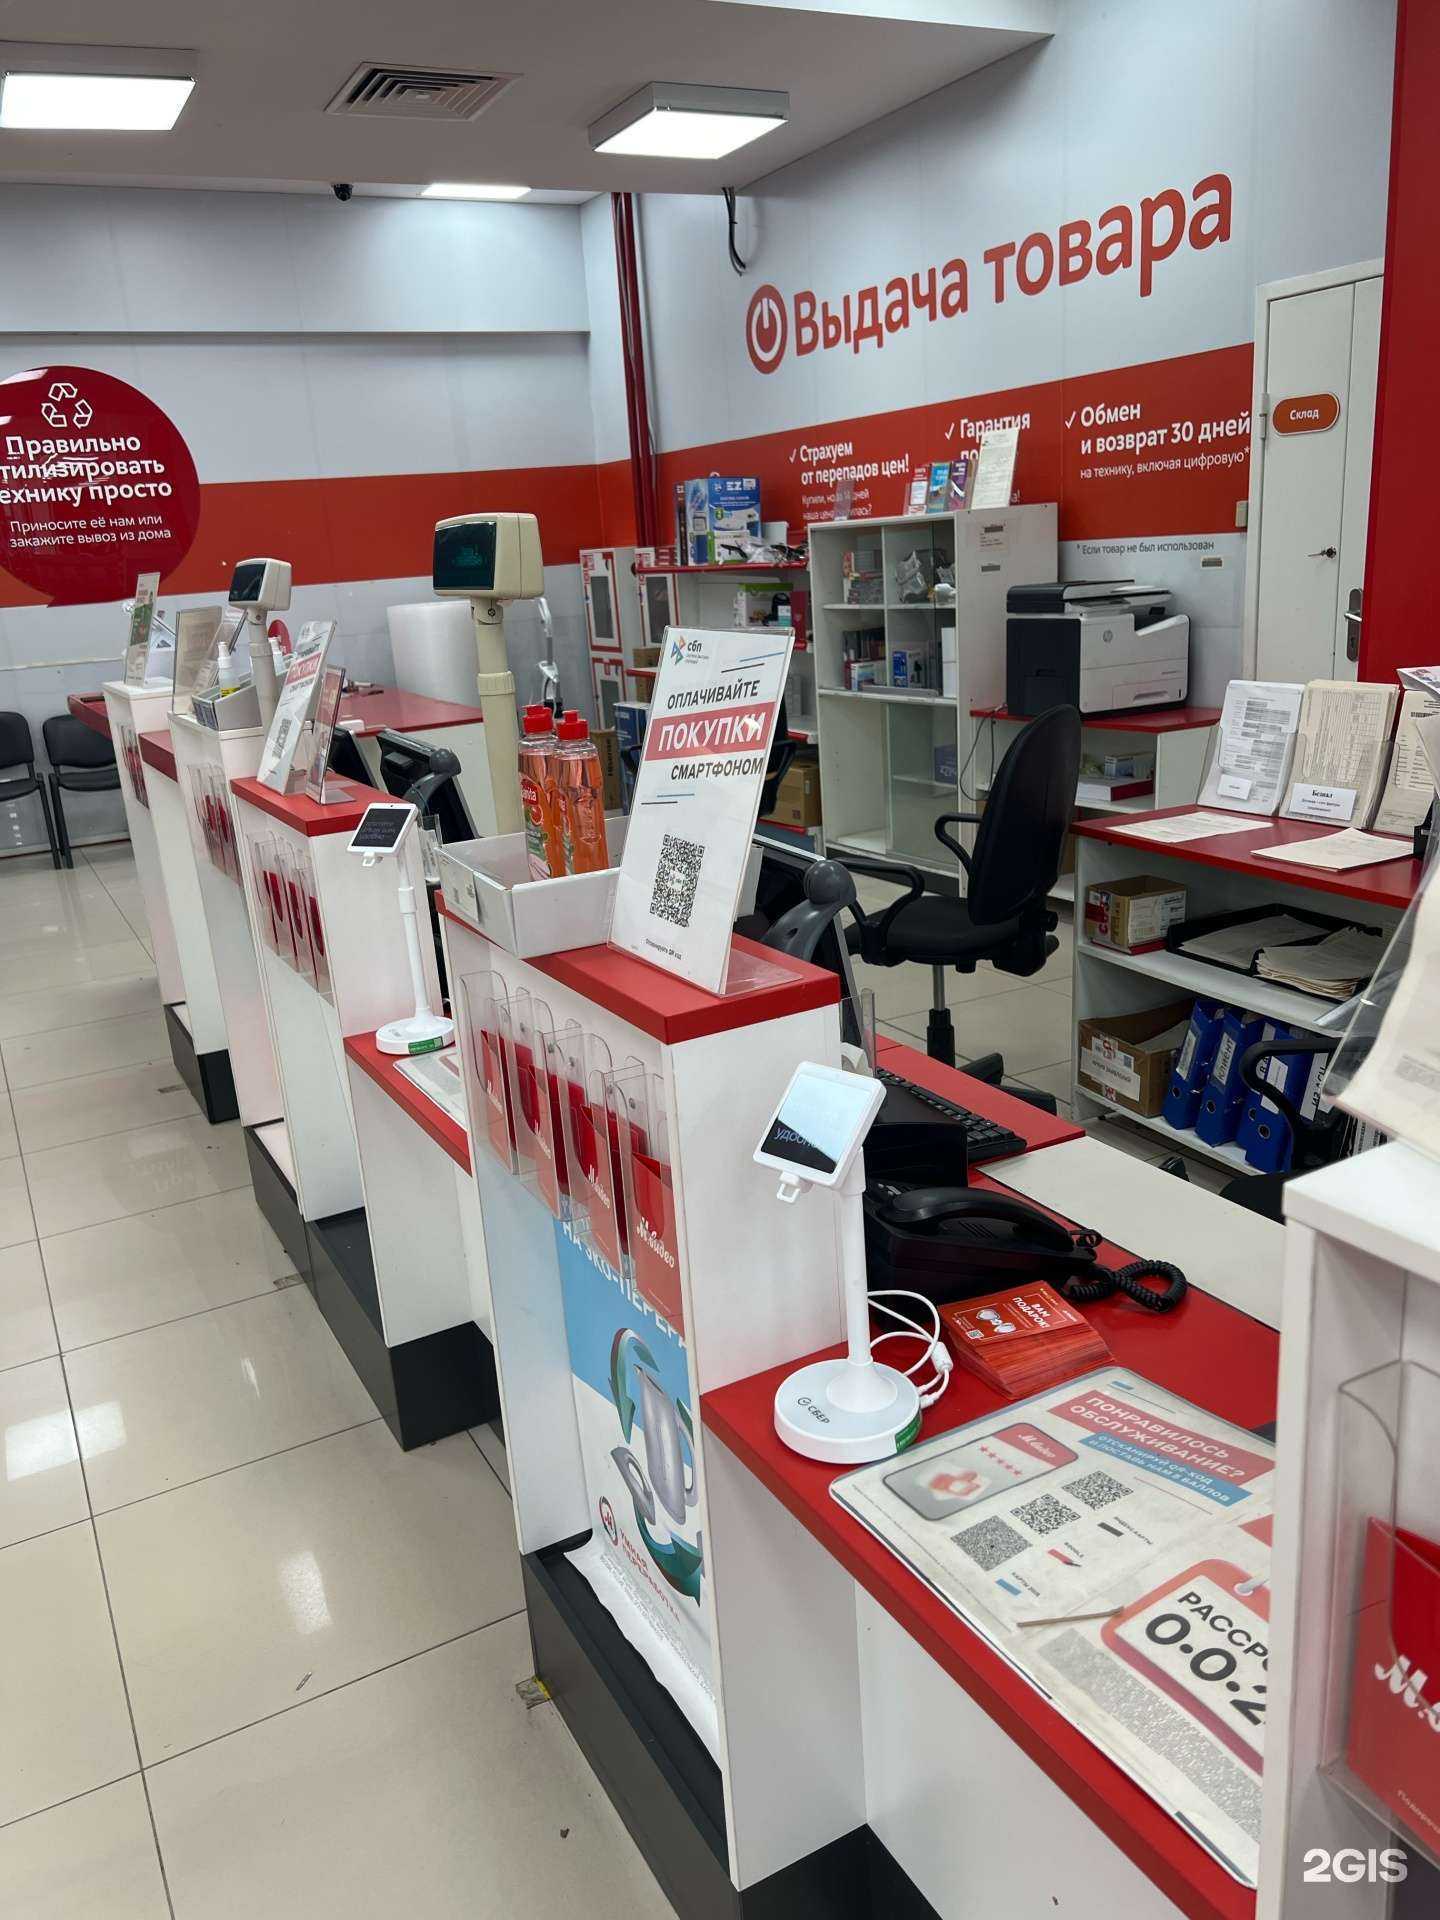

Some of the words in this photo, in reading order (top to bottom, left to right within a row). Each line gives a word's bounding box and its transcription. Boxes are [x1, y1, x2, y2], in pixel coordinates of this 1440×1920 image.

[794, 258, 969, 356] Выдача
[982, 172, 1233, 304] товара
[1080, 403, 1141, 427] Обмен
[1289, 408, 1319, 421] Склад
[960, 413, 1031, 442] Гарантия
[1081, 437, 1091, 455] и
[1097, 427, 1167, 455] возврат
[1171, 421, 1194, 444] 30
[1198, 411, 1251, 443] дней
[5, 436, 141, 461] Правильно
[800, 441, 853, 464] Страхуем
[0, 459, 165, 482] тилизировать
[801, 471, 814, 486] от
[816, 462, 879, 488] перепадов
[882, 454, 910, 476] цен!
[1080, 467, 1092, 480] на
[1094, 461, 1136, 478] технику,
[1137, 458, 1181, 474] включая
[0, 485, 83, 508] ехнику
[89, 482, 172, 505] просто
[10, 520, 87, 535] Приносите
[90, 516, 106, 528] её
[109, 516, 135, 528] нам
[138, 515, 163, 526] или
[10, 533, 74, 548] закажите
[78, 532, 117, 544] вывоз
[120, 531, 135, 541] из
[137, 529, 172, 542] дома
[1082, 544, 1100, 555] Если
[1102, 544, 1125, 556] товар
[1127, 545, 1137, 553] не
[1139, 541, 1155, 553] был
[1157, 541, 1215, 554] использован
[687, 639, 702, 653] сбп
[667, 677, 760, 710] ОПЛАЧИВАЙТЕ
[658, 712, 766, 752] ПОКУПКИ
[671, 757, 764, 780] СМАРТФОНОМ
[808, 1405, 830, 1424] СБЕР
[1086, 1397, 1229, 1459] ПОНРАВИЛОСЬ
[1070, 1404, 1246, 1478] ОБСЛУЖИВАНИЕ?
